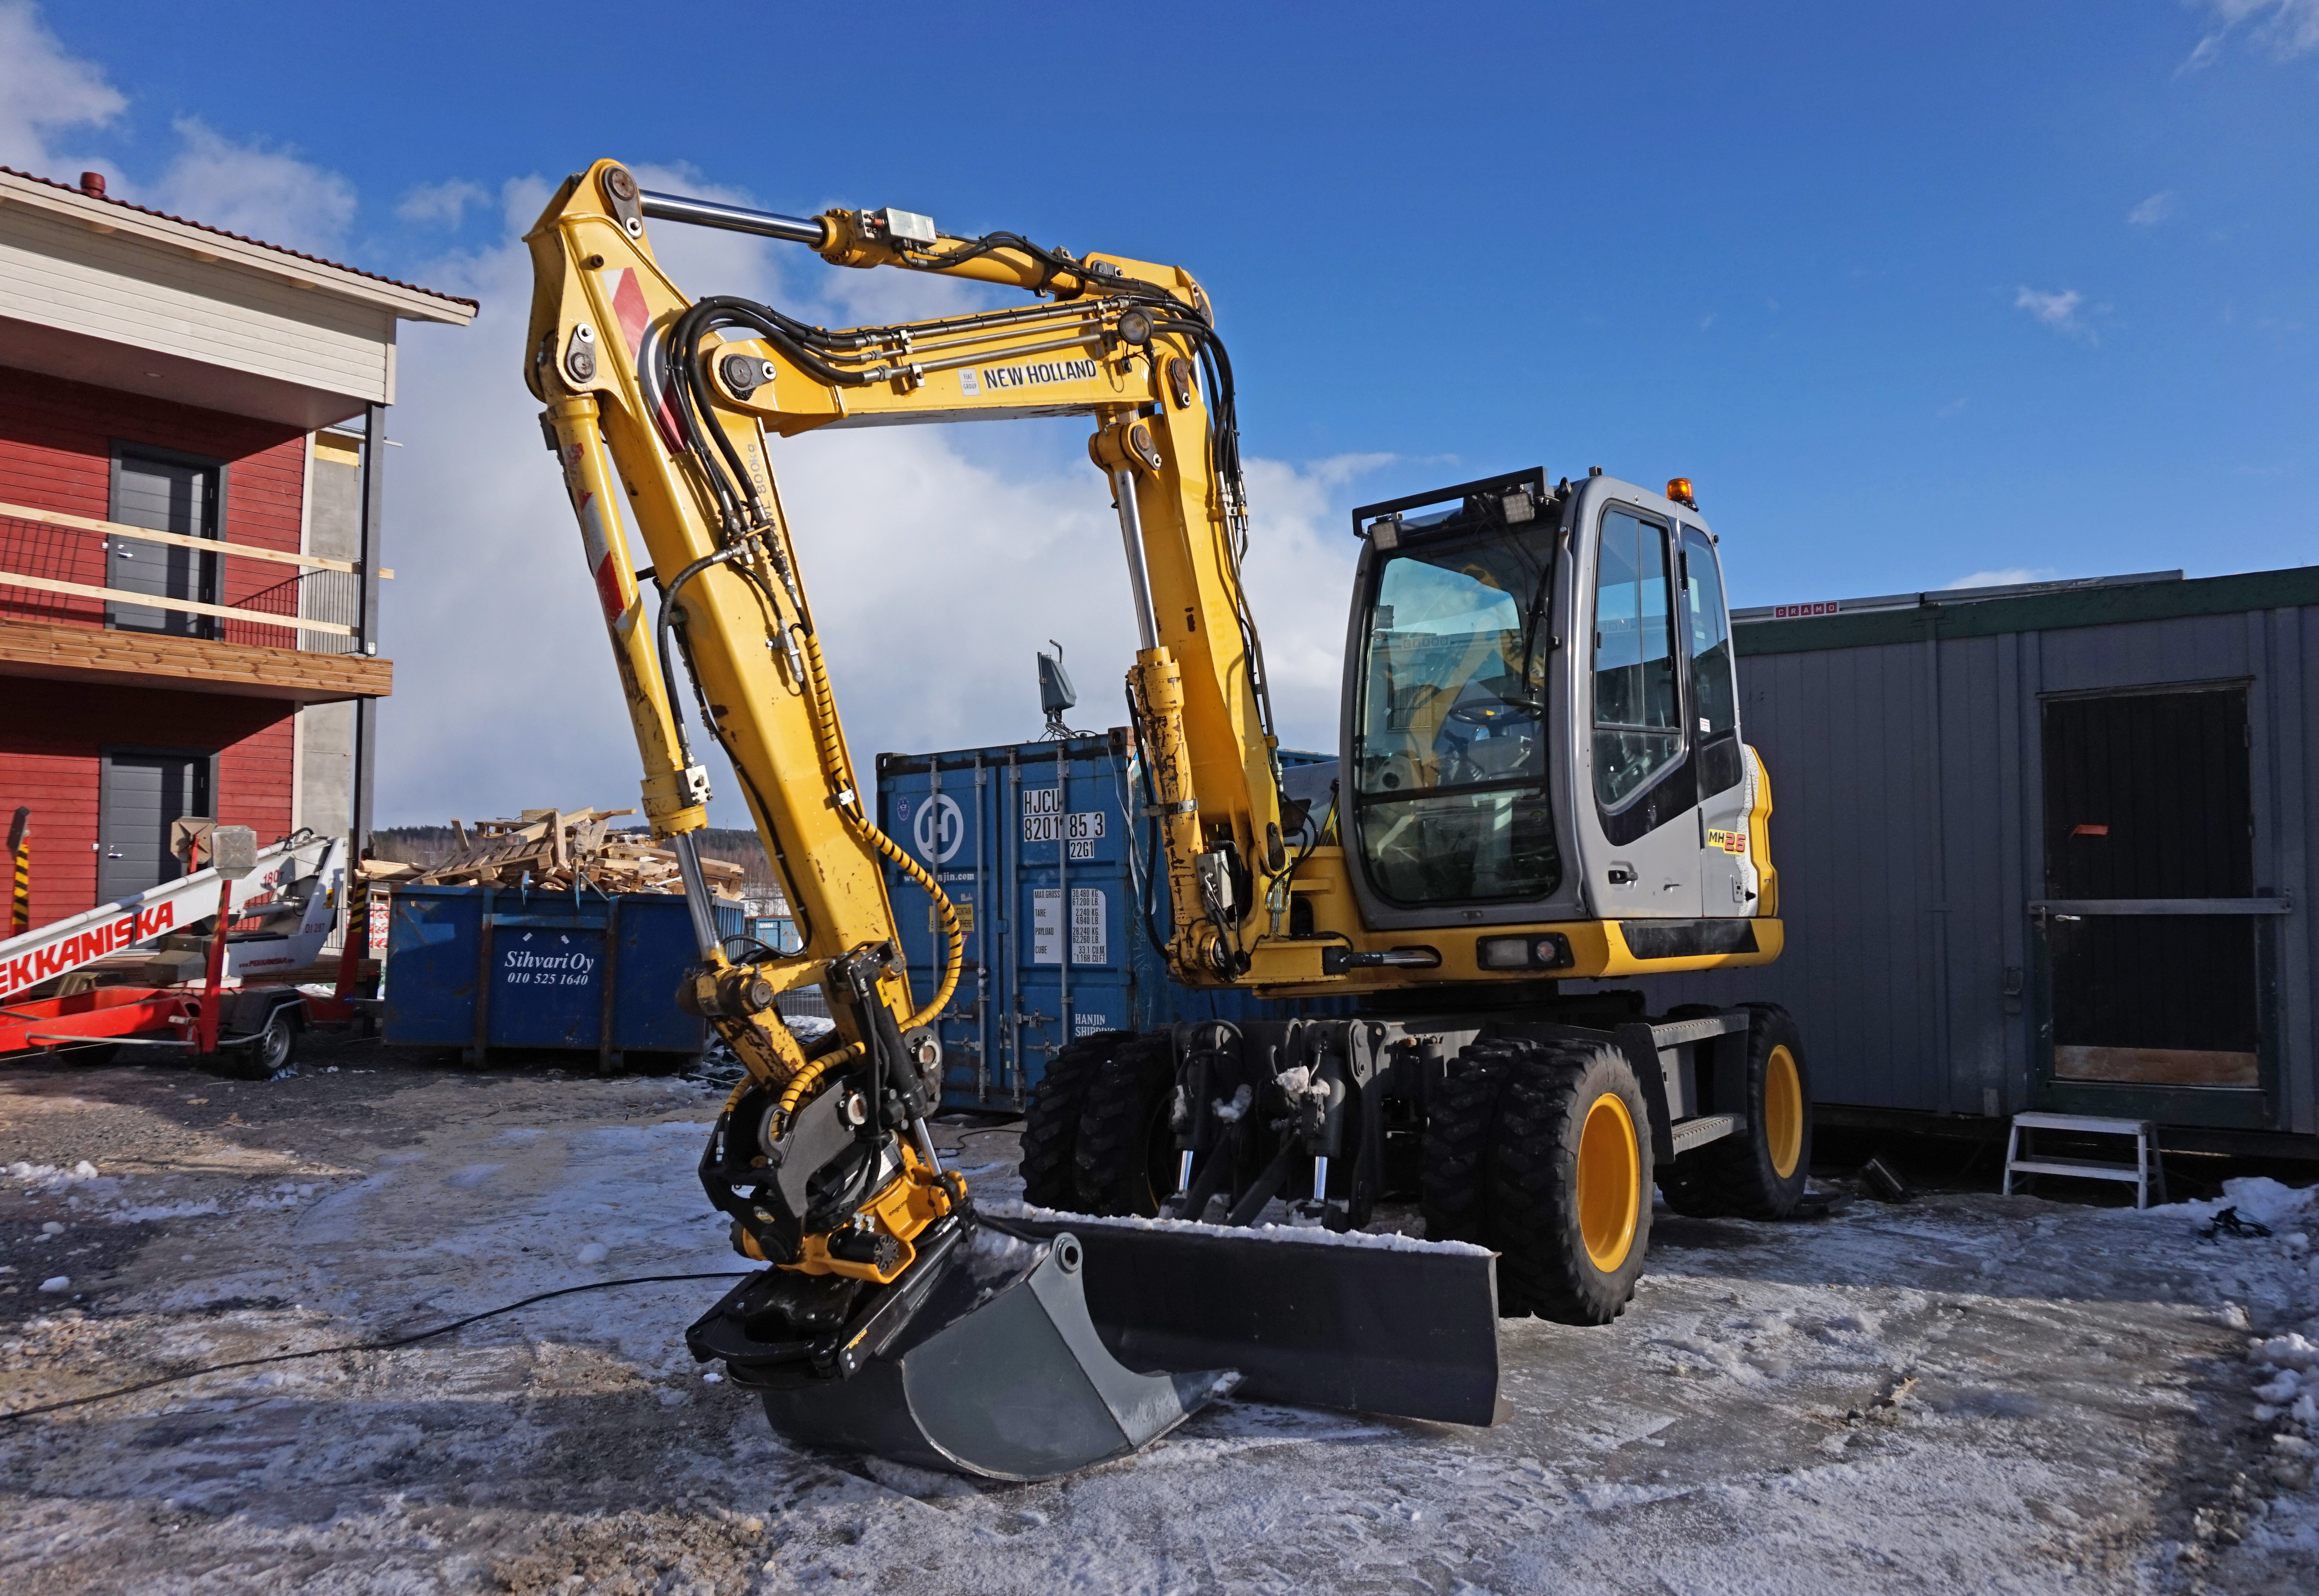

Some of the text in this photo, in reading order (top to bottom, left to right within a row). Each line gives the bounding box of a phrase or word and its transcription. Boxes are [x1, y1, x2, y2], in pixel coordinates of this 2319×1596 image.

[984, 359, 1096, 389] NEW HOLLAND
[1779, 604, 1834, 615] CRAMO
[1024, 790, 1060, 814] HJCU
[1025, 813, 1104, 840] 8201 85 3
[1070, 841, 1093, 857] 22G1
[1035, 909, 1046, 917] TARE
[1035, 927, 1054, 935] PAYLOAD
[1079, 946, 1089, 954] 33.1
[504, 951, 594, 973] Sihvari Oy
[507, 972, 588, 985] 010 525 1640
[1075, 1014, 1105, 1026] HANJIN
[849, 1329, 867, 1349] engcon
